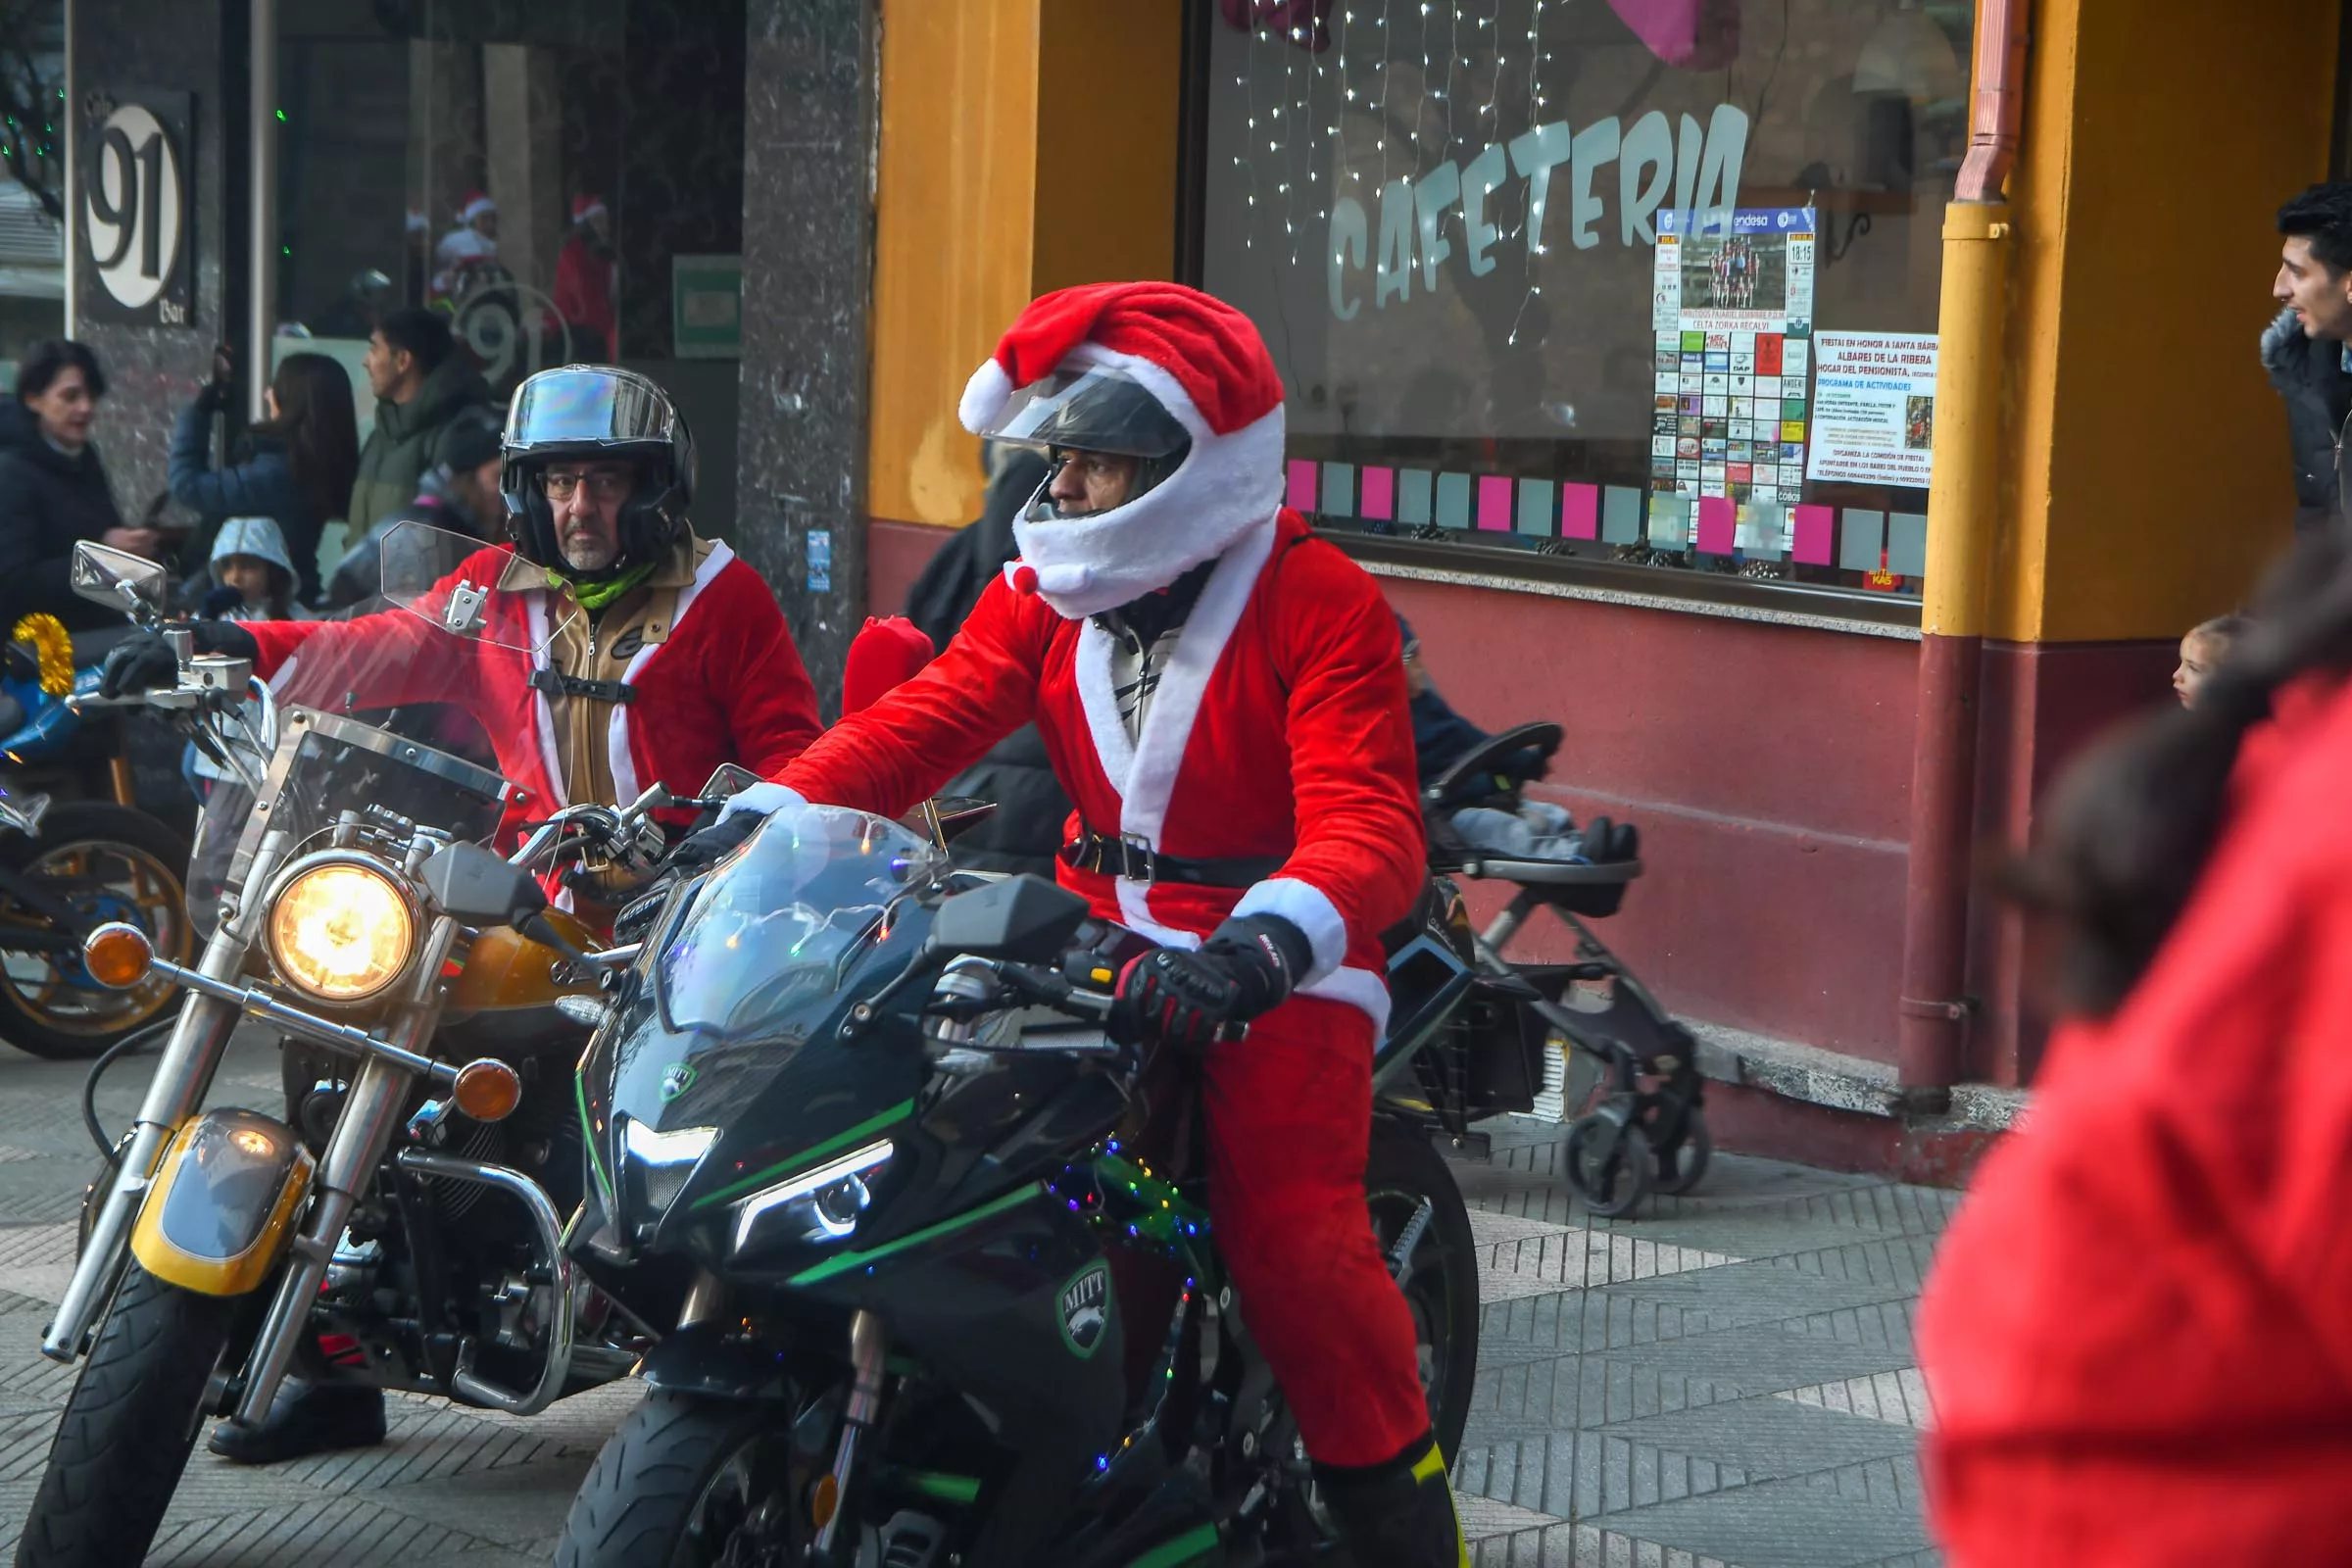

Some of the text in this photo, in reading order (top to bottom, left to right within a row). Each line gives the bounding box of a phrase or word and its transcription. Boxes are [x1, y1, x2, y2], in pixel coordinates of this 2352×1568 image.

[87, 126, 164, 280] 91
[1327, 103, 1749, 321] CAFETERIA
[1733, 215, 1768, 226] endesa
[1791, 246, 1811, 261] 18:15
[159, 298, 185, 324] Bar
[1692, 320, 1769, 330] CELTA ZORKA RECALVI
[1821, 338, 1844, 347] FIESTAS
[1846, 339, 1856, 348] EN
[1857, 340, 1884, 349] HONOR
[1884, 341, 1890, 350] A
[1892, 341, 1916, 350] SANTA
[1838, 351, 1932, 366] ALBARES DE LA RIBERA
[1817, 364, 1841, 373] HOGAR
[1842, 365, 1857, 374] DEL
[1817, 378, 1912, 392] PROGRAMA DE ACTIVIDADES
[1833, 449, 1861, 458] ORGANIZA
[1904, 453, 1925, 463] FIESTAS
[1897, 464, 1919, 472] PUEBLO
[1779, 492, 1801, 502] COBOS
[1064, 1270, 1103, 1313] MITT
